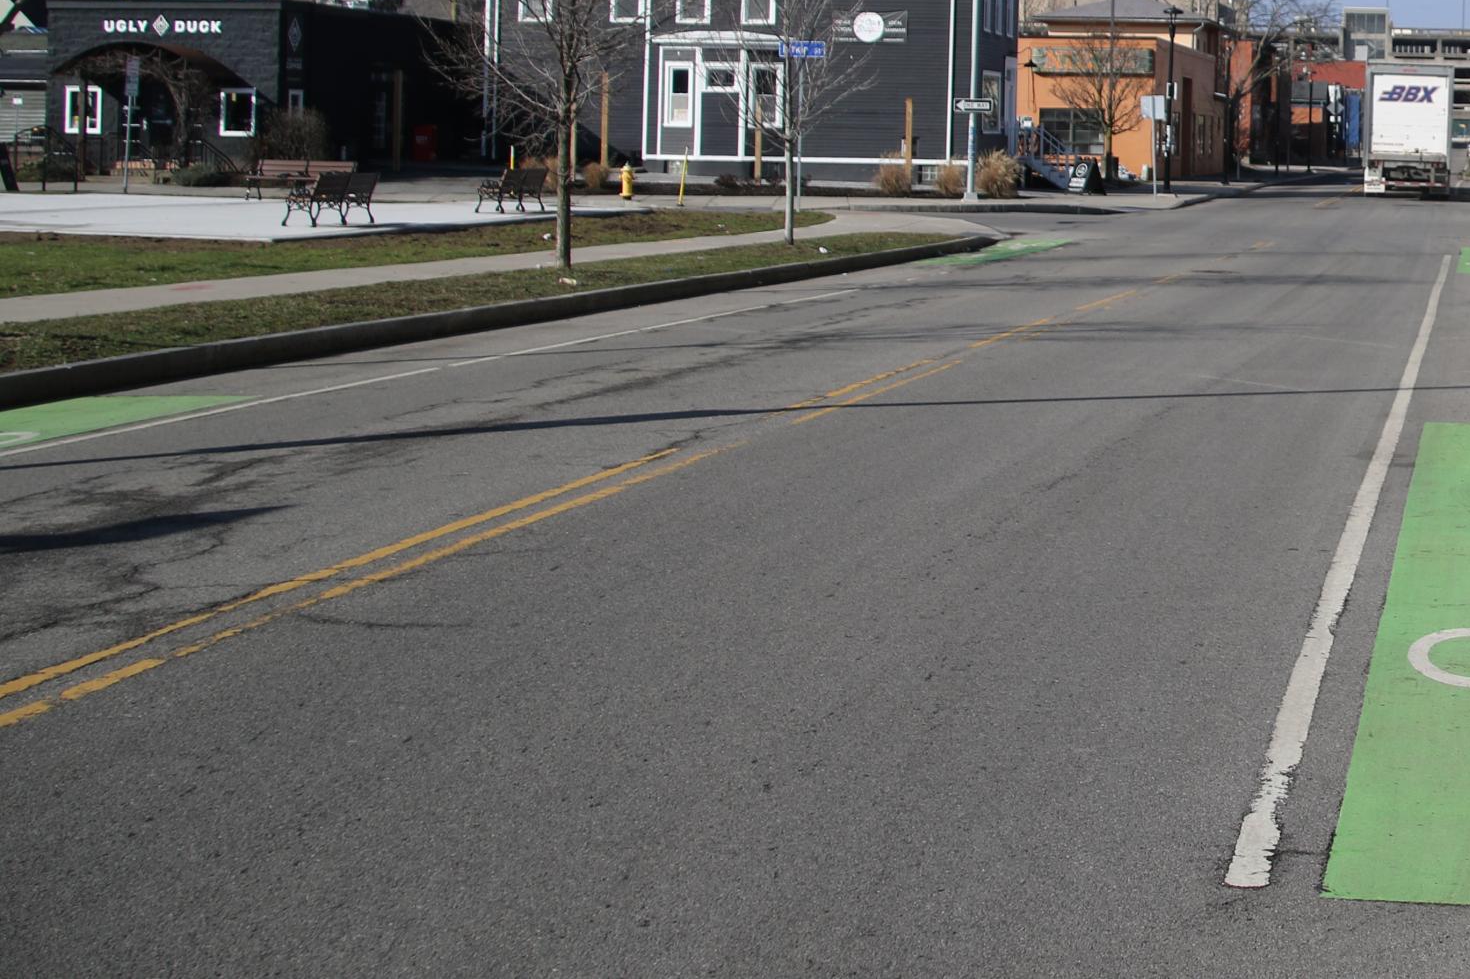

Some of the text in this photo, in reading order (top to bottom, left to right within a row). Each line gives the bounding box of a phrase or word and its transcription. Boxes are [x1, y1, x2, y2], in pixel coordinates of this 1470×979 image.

[103, 19, 222, 34] UGLY DUCK
[1380, 84, 1440, 103] BBX
